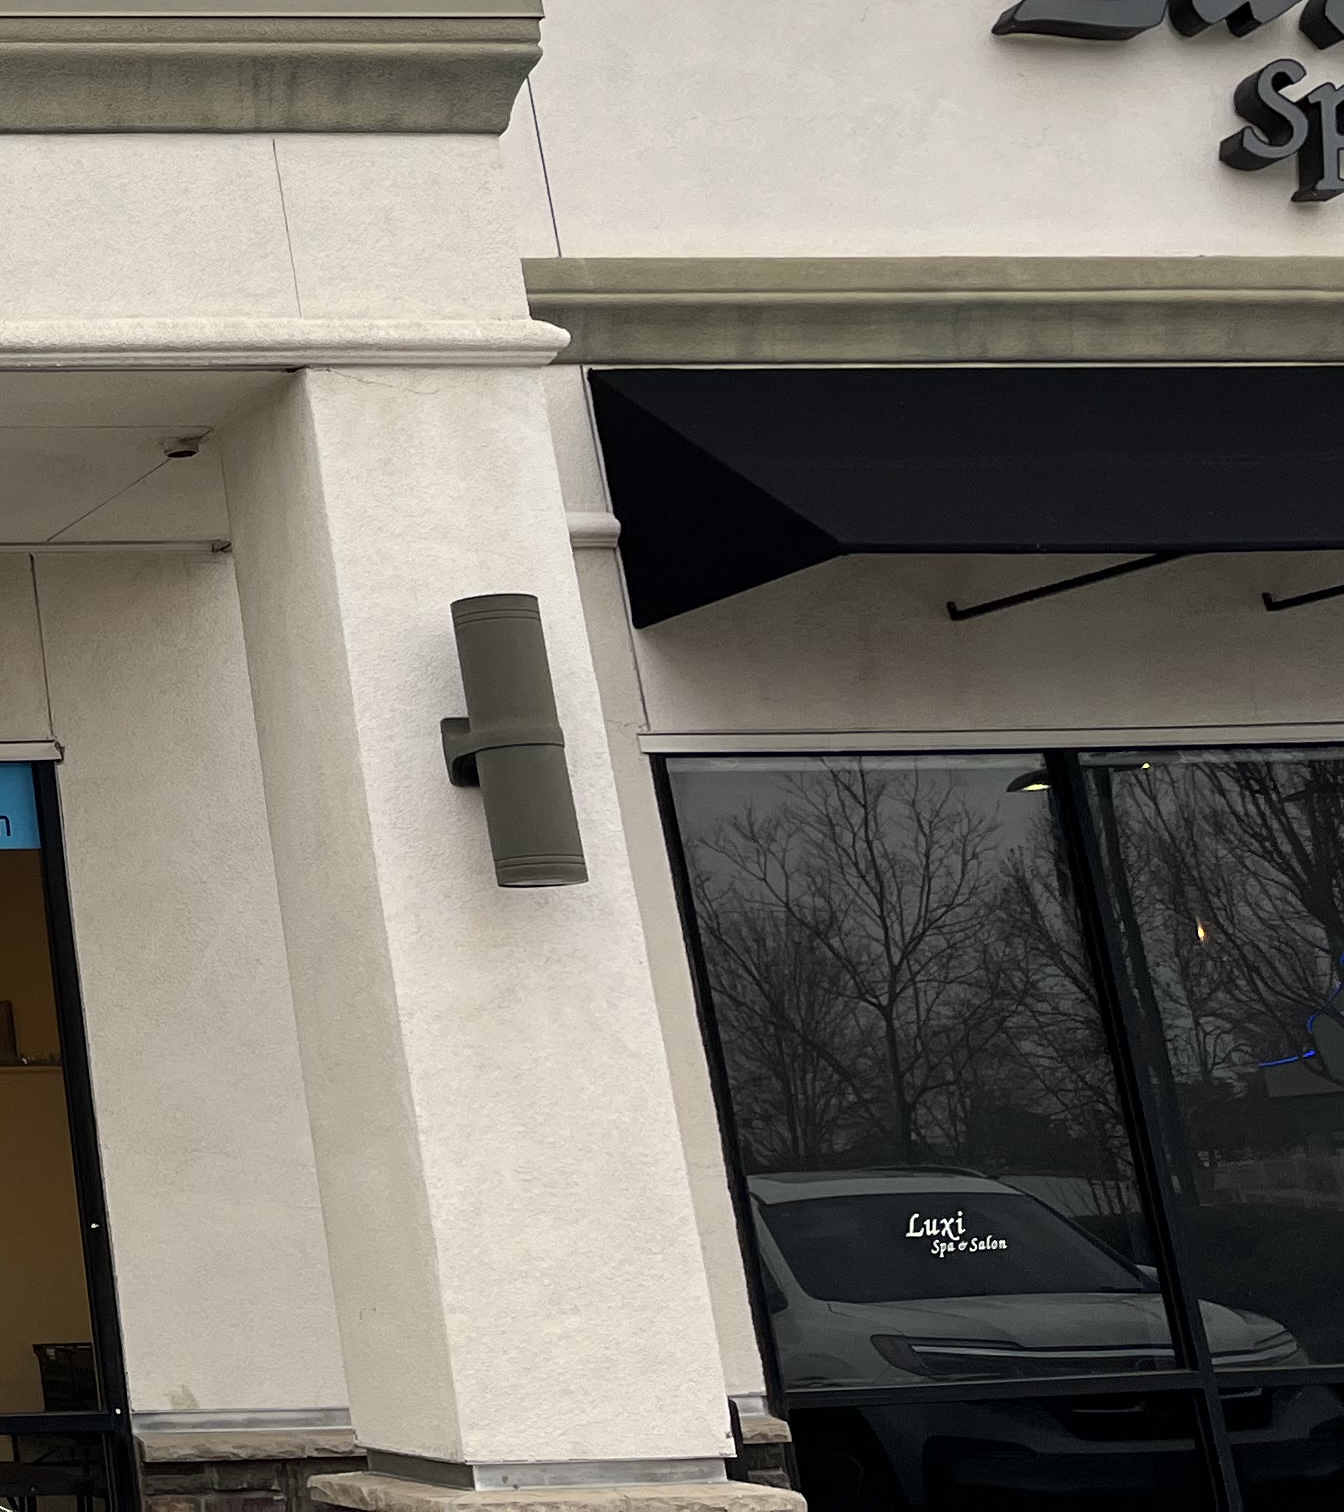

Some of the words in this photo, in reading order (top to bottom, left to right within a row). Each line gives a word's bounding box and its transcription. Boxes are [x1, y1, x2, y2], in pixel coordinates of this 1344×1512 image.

[905, 1210, 966, 1241] Luxi
[931, 1239, 955, 1258] Spa
[969, 1235, 1008, 1252] Salon
